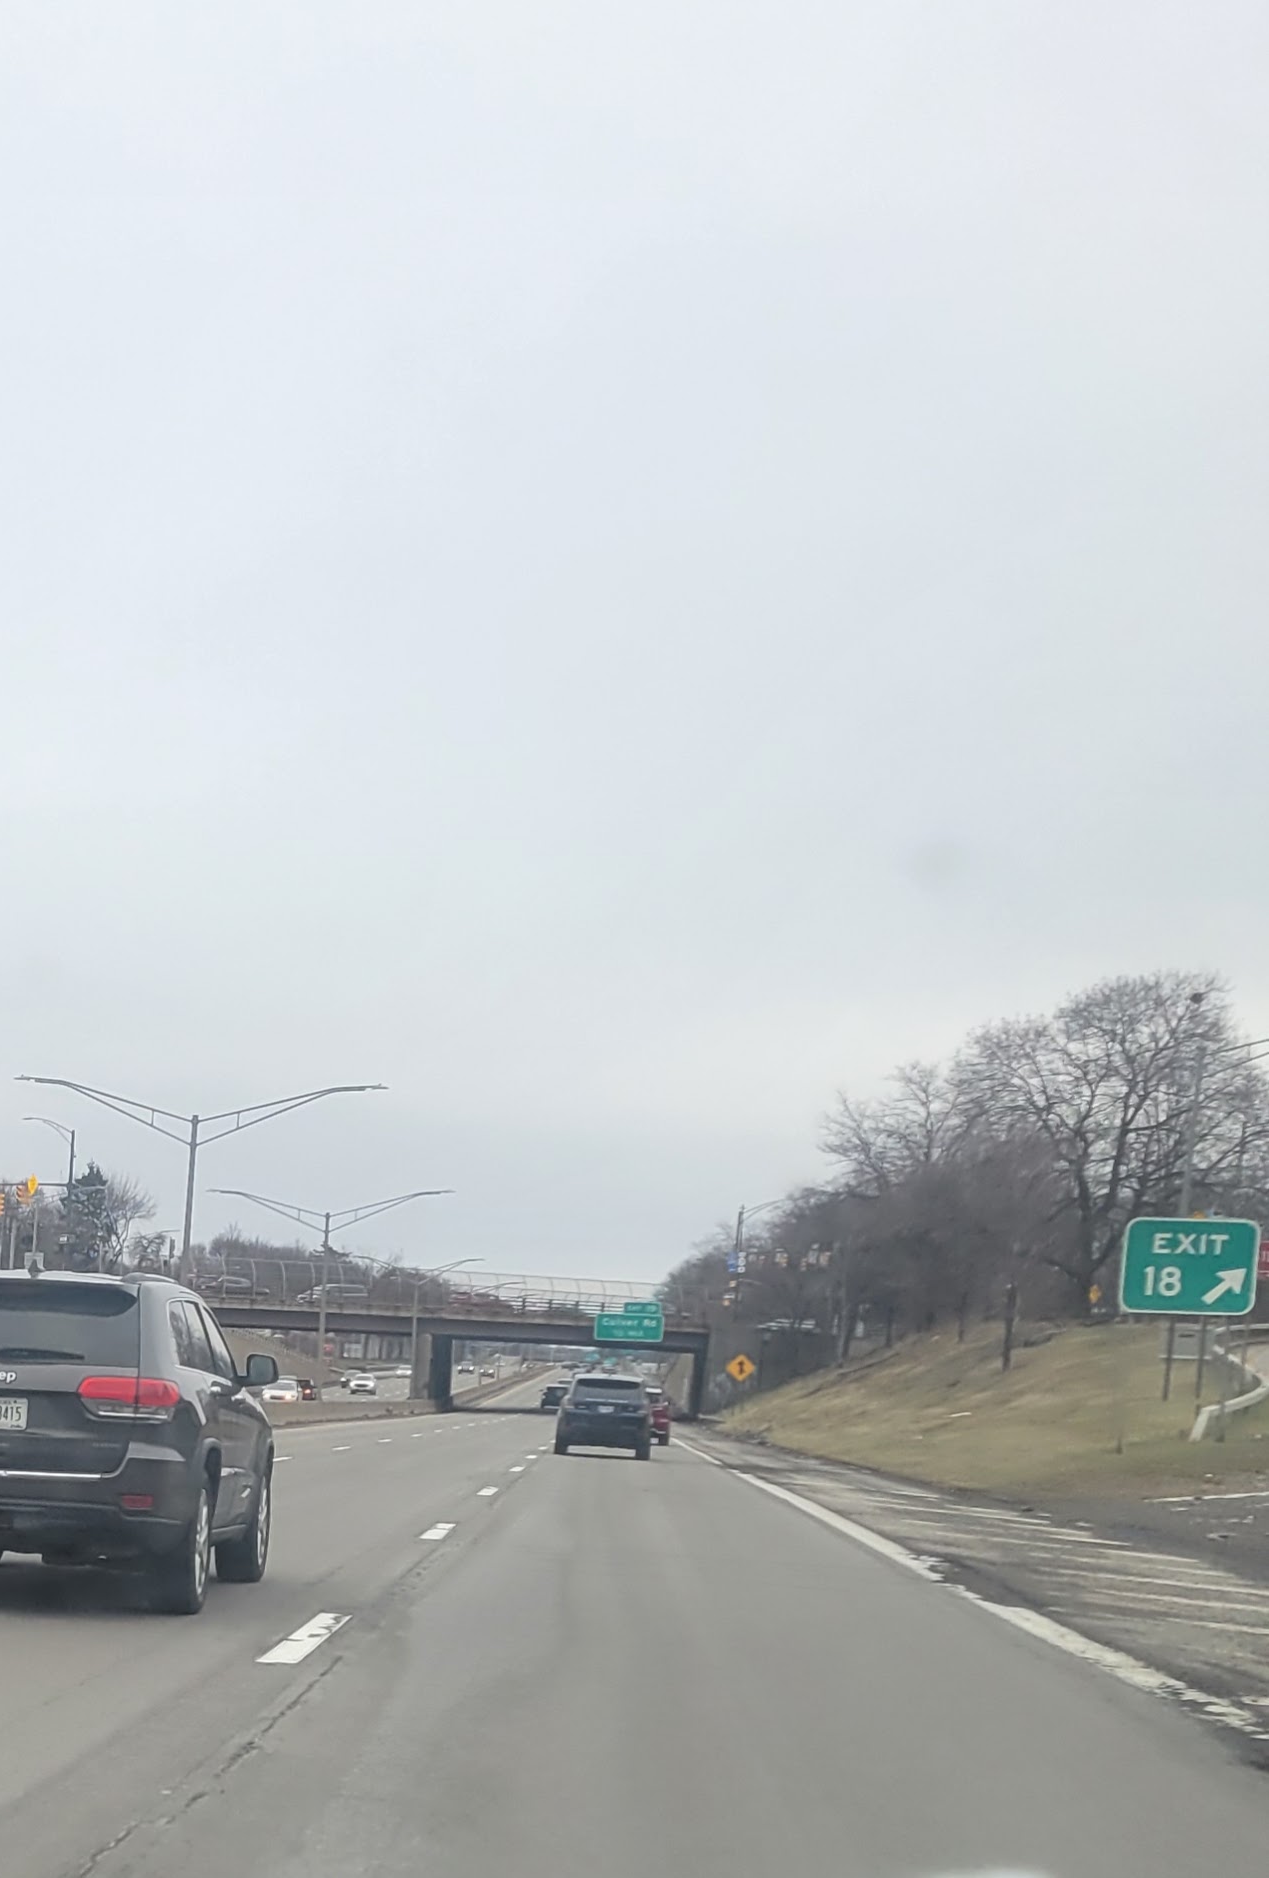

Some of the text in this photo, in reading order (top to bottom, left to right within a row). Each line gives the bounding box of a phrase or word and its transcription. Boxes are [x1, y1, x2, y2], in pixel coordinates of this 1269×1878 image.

[1152, 1232, 1230, 1255] EXIT
[1143, 1265, 1182, 1296] 18
[642, 1318, 657, 1328] Rd
